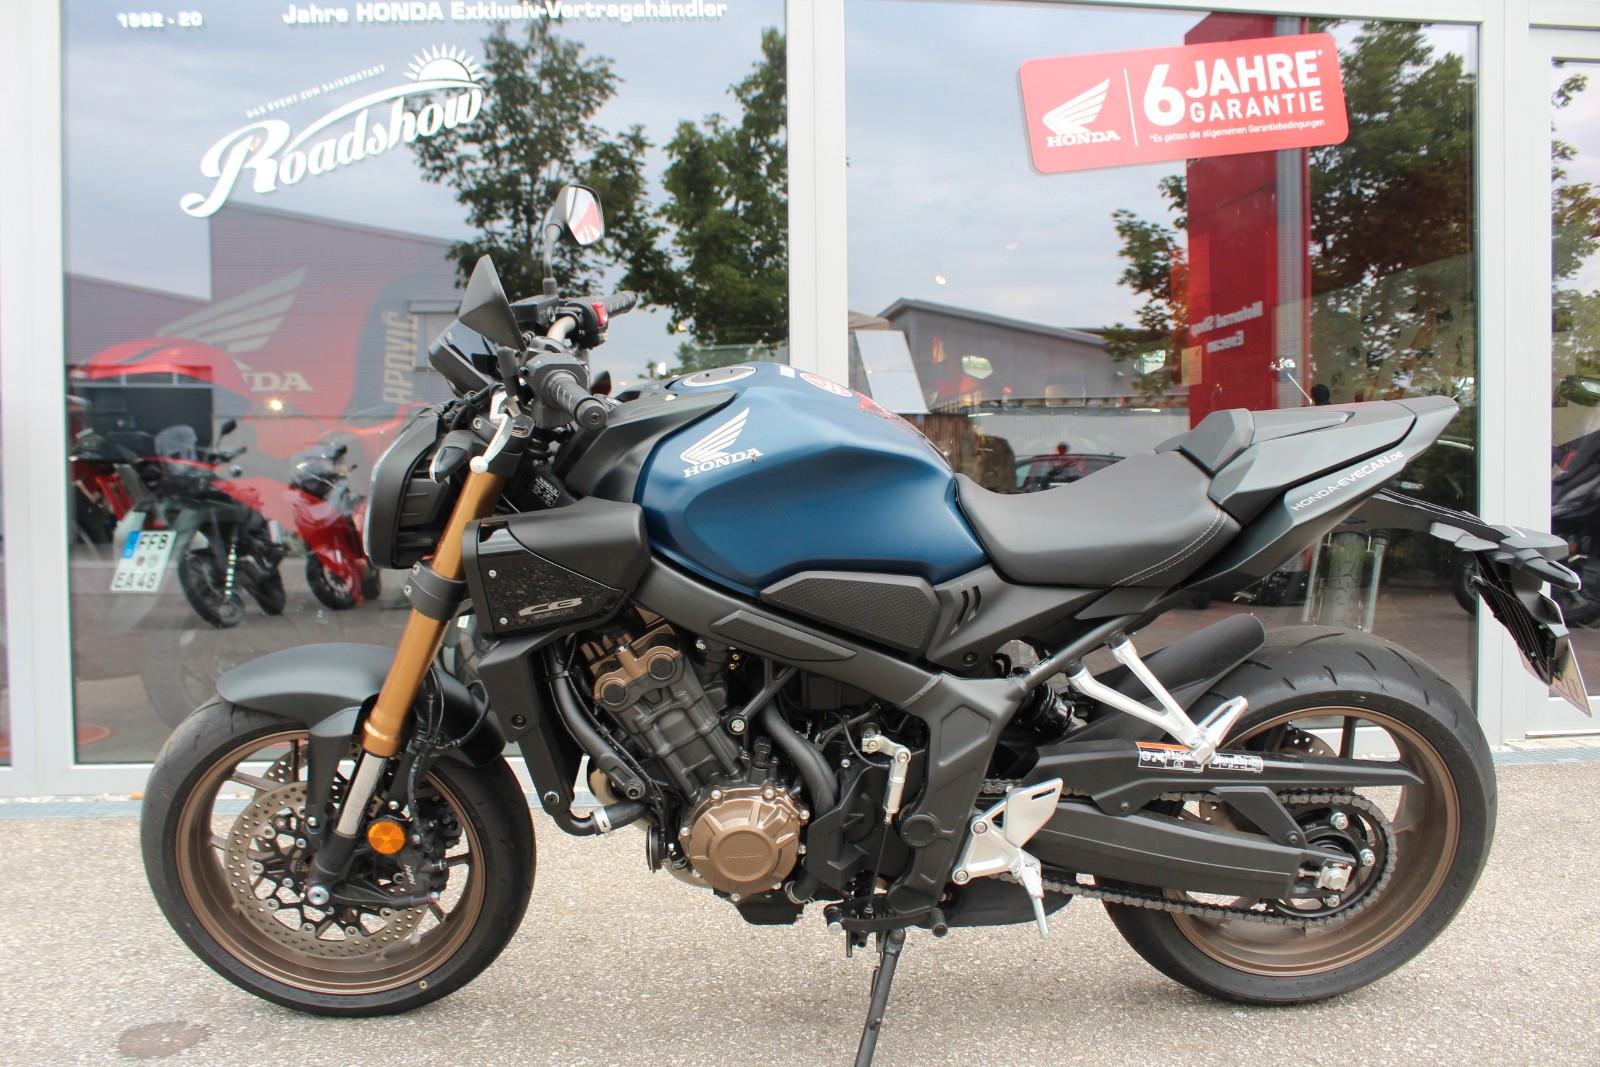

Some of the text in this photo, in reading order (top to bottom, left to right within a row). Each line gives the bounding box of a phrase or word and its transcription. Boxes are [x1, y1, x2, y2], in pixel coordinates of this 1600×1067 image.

[282, 4, 349, 24] Jahre
[356, 1, 444, 22] HONDA
[451, 1, 728, 22] Exklusiv-Vertragshändler
[1143, 63, 1186, 127] 6
[1190, 91, 1325, 123] GARANTIE
[1046, 130, 1122, 148] HONDA
[1189, 128, 1201, 140] die
[1202, 124, 1247, 139] allgemeinen
[1248, 119, 1326, 134] Garantiebedingungen
[180, 88, 483, 218] Roadshow
[683, 447, 765, 479] HONDA
